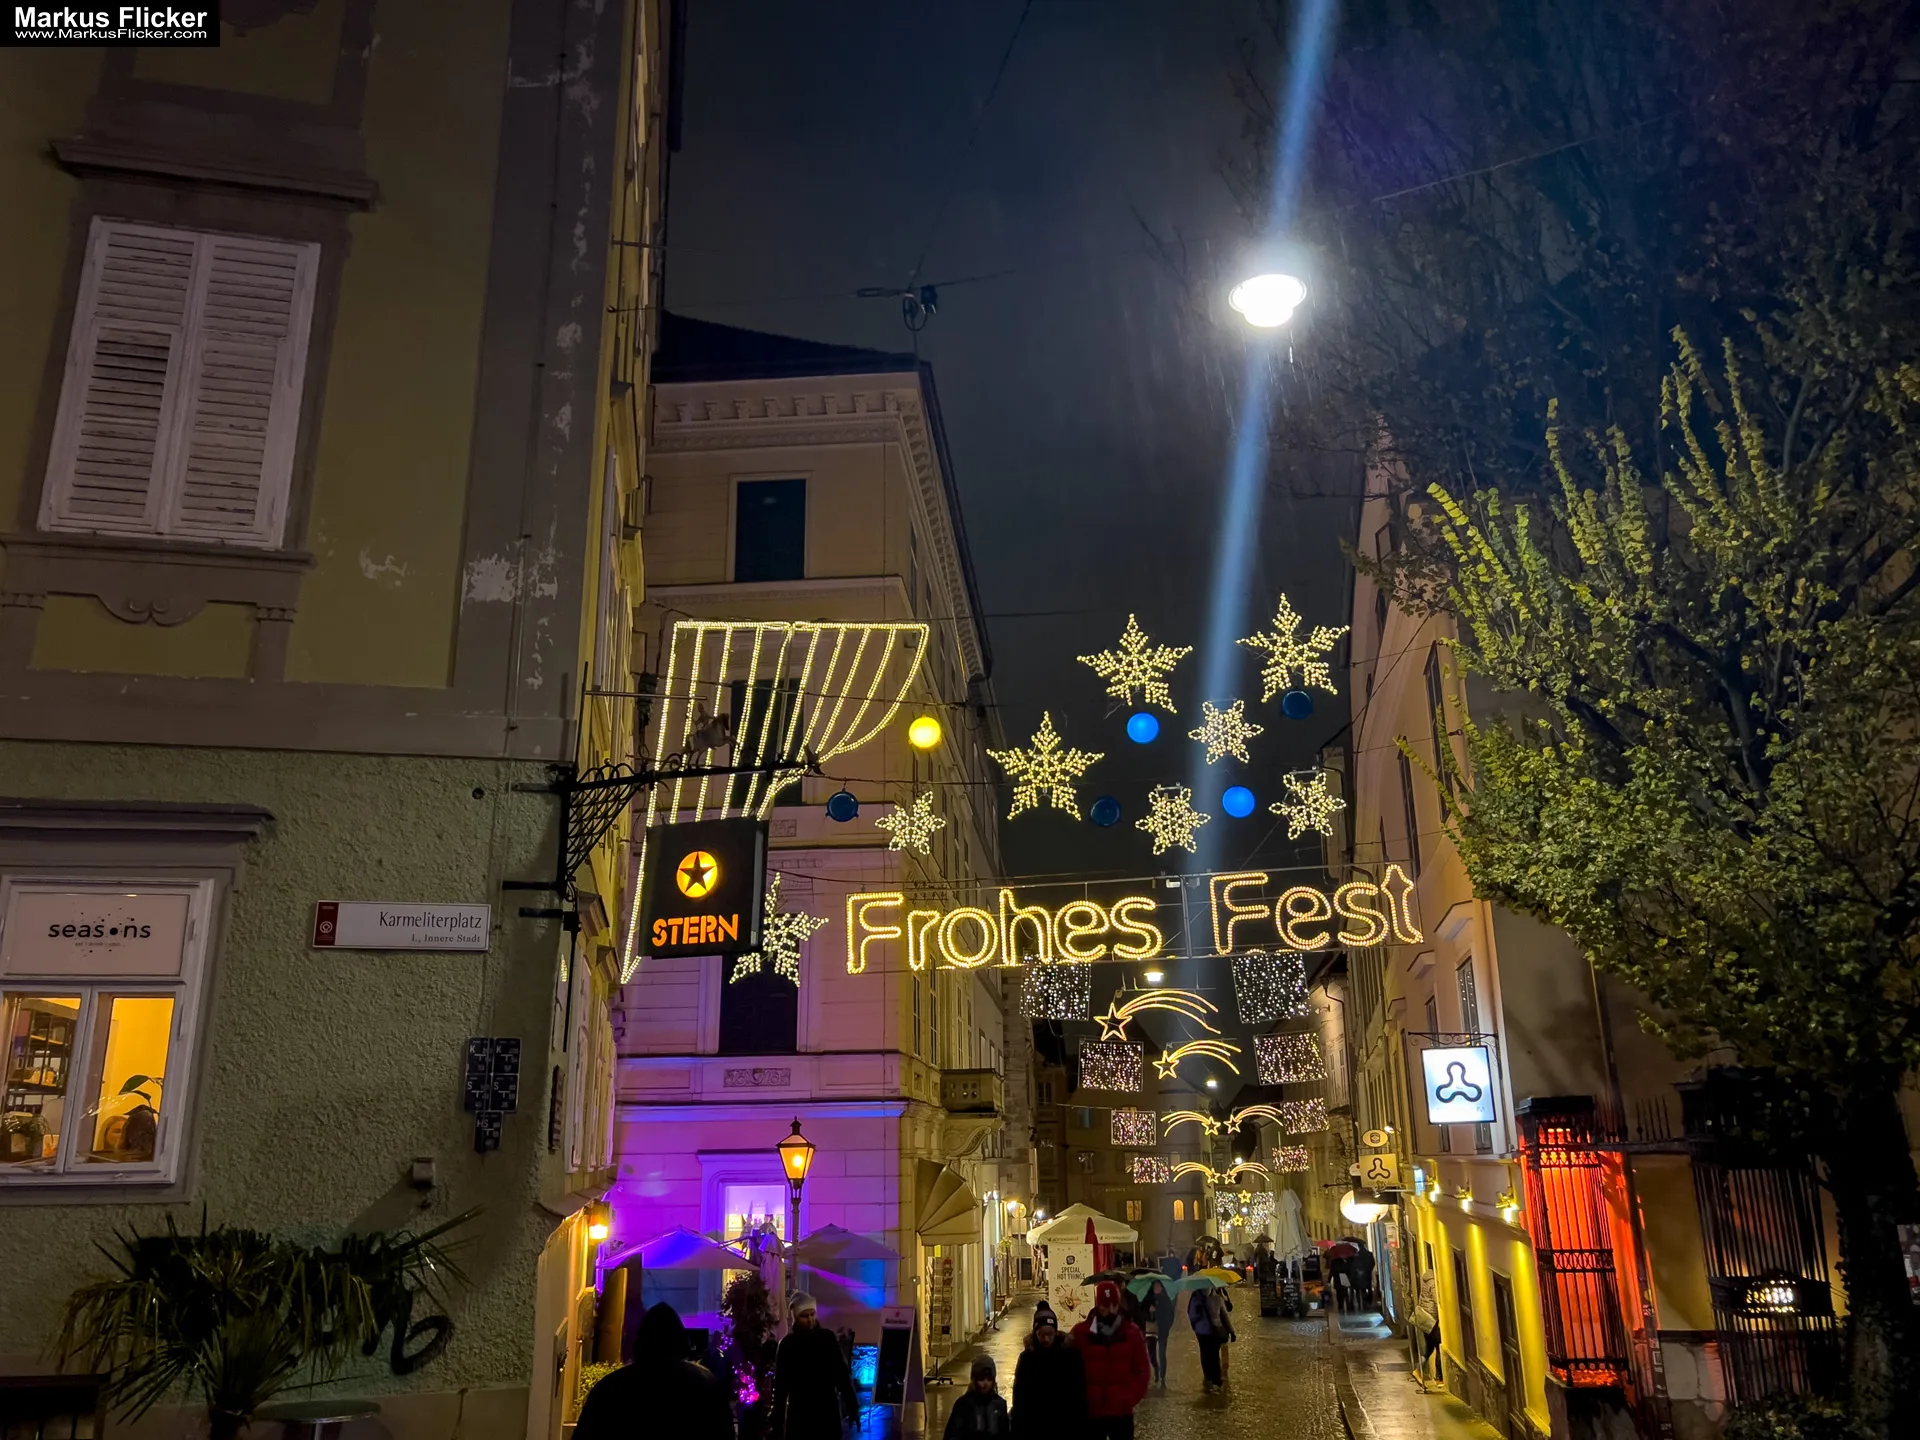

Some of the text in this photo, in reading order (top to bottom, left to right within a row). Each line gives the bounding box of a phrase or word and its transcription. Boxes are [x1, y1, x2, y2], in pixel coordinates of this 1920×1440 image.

[379, 911, 482, 932] Karmeliterplatz
[651, 913, 739, 947] STERN
[846, 863, 1424, 975] Frohes Fest
[424, 934, 454, 943] Innere
[456, 934, 481, 943] Stadt
